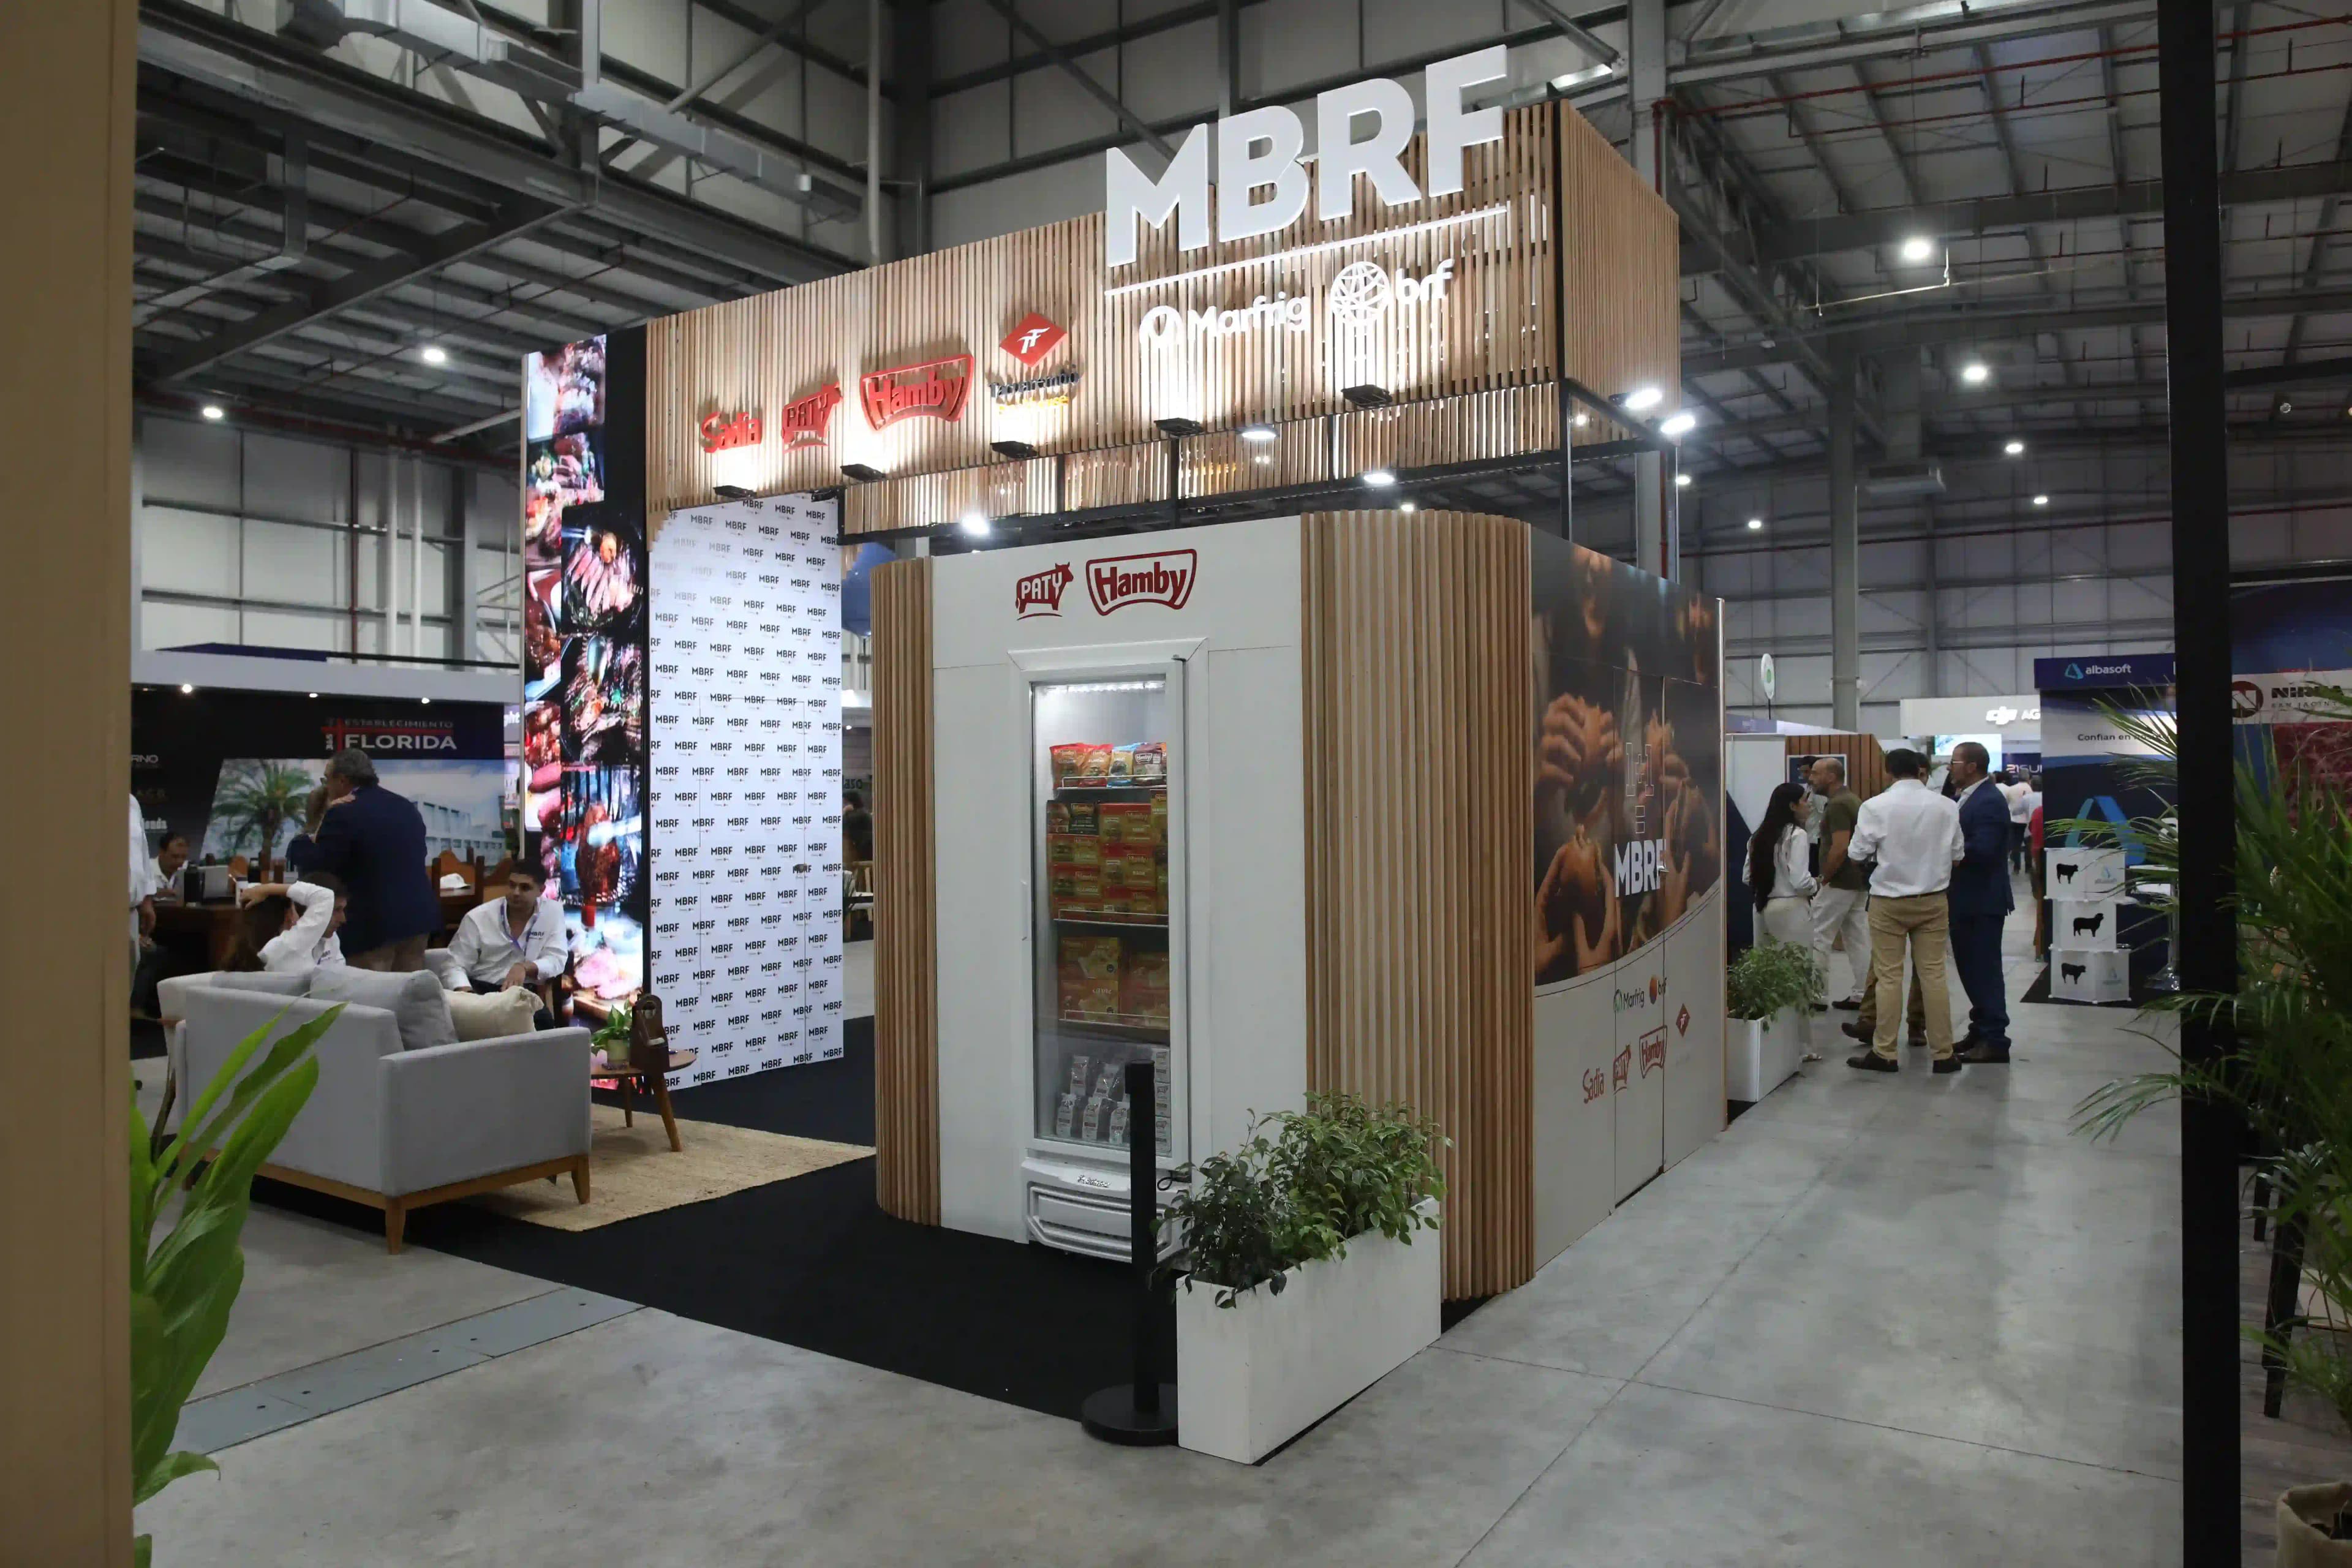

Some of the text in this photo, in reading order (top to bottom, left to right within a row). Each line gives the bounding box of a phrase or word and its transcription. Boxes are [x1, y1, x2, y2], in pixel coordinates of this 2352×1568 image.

[1106, 44, 1507, 268] MBRF
[1188, 258, 1455, 339] Marfrig brf
[868, 371, 963, 425] Hamby
[701, 412, 761, 453] Sadia
[743, 500, 763, 509] MBRF
[775, 504, 795, 514] MBRF
[691, 514, 713, 525] MBRF
[806, 510, 826, 520] MBRF
[725, 520, 747, 530] MBRF
[759, 525, 779, 536] MBRF
[791, 530, 810, 541] MBRF
[743, 547, 764, 558] MBRF
[775, 552, 795, 562] MBRF
[806, 557, 826, 567] MBRF
[759, 575, 779, 584] MBRF
[791, 578, 810, 588] MBRF
[1095, 562, 1187, 606] Hamby
[1021, 572, 1062, 600] PATY
[744, 600, 764, 609] MBRF
[776, 603, 796, 614] MBRF
[655, 612, 679, 622] MBRF
[807, 608, 827, 617] MBRF
[692, 616, 714, 626] MBRF
[726, 620, 748, 630] MBRF
[760, 624, 780, 633] MBRF
[792, 627, 811, 636] MBRF
[674, 640, 697, 650] MBRF
[710, 643, 732, 653] MBRF
[744, 647, 764, 655] MBRF
[777, 649, 797, 658] MBRF
[808, 652, 826, 661] MBRF
[655, 664, 679, 674] MBRF
[692, 666, 714, 676] MBRF
[2086, 663, 2132, 674] albasoft
[726, 669, 748, 679] MBRF
[760, 672, 780, 681] MBRF
[792, 674, 812, 684] MBRF
[655, 715, 679, 724] MBRF
[727, 718, 748, 727] MBRF
[761, 720, 781, 728] MBRF
[345, 735, 457, 750] FLORIDA
[674, 741, 698, 750] MBRF
[710, 742, 733, 751] MBRF
[745, 743, 766, 752] MBRF
[777, 744, 797, 753] MBRF
[655, 766, 679, 775] MBRF
[727, 767, 749, 776] MBRF
[760, 767, 781, 776] MBRF
[710, 792, 733, 801] MBRF
[745, 792, 766, 801] MBRF
[777, 792, 797, 801] MBRF
[656, 819, 679, 828] MBRF
[728, 817, 749, 826] MBRF
[761, 816, 781, 826] MBRF
[711, 846, 733, 856] MBRF
[745, 845, 766, 854] MBRF
[777, 844, 797, 853] MBRF
[728, 868, 749, 877] MBRF
[761, 866, 782, 876] MBRF
[823, 863, 841, 872] MBRF
[1615, 839, 1667, 898] MBRF
[656, 872, 680, 881] MBRF
[693, 870, 715, 880] MBRF
[745, 892, 766, 901] MBRF
[777, 889, 797, 899] MBRF
[809, 888, 827, 896] MBRF
[676, 897, 698, 906] MBRF
[711, 894, 733, 903] MBRF
[728, 917, 749, 927] MBRF
[761, 914, 782, 924] MBRF
[656, 923, 680, 933] MBRF
[693, 921, 715, 930] MBRF
[777, 937, 798, 947] MBRF
[809, 935, 827, 943] MBRF
[711, 943, 733, 954] MBRF
[745, 940, 766, 950] MBRF
[676, 948, 698, 957] MBRF
[793, 959, 812, 968] MBRF
[823, 955, 842, 964] MBRF
[728, 965, 750, 976] MBRF
[761, 962, 782, 972] MBRF
[657, 973, 680, 985] MBRF
[693, 970, 715, 979] MBRF
[778, 984, 798, 994] MBRF
[809, 980, 827, 989] MBRF
[711, 992, 734, 1003] MBRF
[745, 988, 766, 998] MBRF
[676, 997, 699, 1008] MBRF
[1624, 988, 1645, 1009] Marfrig
[793, 1006, 812, 1016] MBRF
[823, 1001, 842, 1011] MBRF
[761, 1009, 782, 1020] MBRF
[693, 1019, 715, 1031] MBRF
[728, 1014, 750, 1026] MBRF
[665, 1025, 680, 1035] BRF
[809, 1027, 827, 1036] MBRF
[778, 1031, 798, 1042] MBRF
[745, 1036, 766, 1048] MBRF
[712, 1041, 734, 1054] MBRF
[1642, 1035, 1664, 1070] Hamby
[793, 1053, 812, 1063] MBRF
[823, 1048, 842, 1058] MBRF
[761, 1058, 782, 1070] MBRF
[728, 1064, 750, 1076] MBRF
[693, 1070, 715, 1083] MBRF
[666, 1077, 680, 1087] BRF
[1583, 1068, 1604, 1104] Sadia
